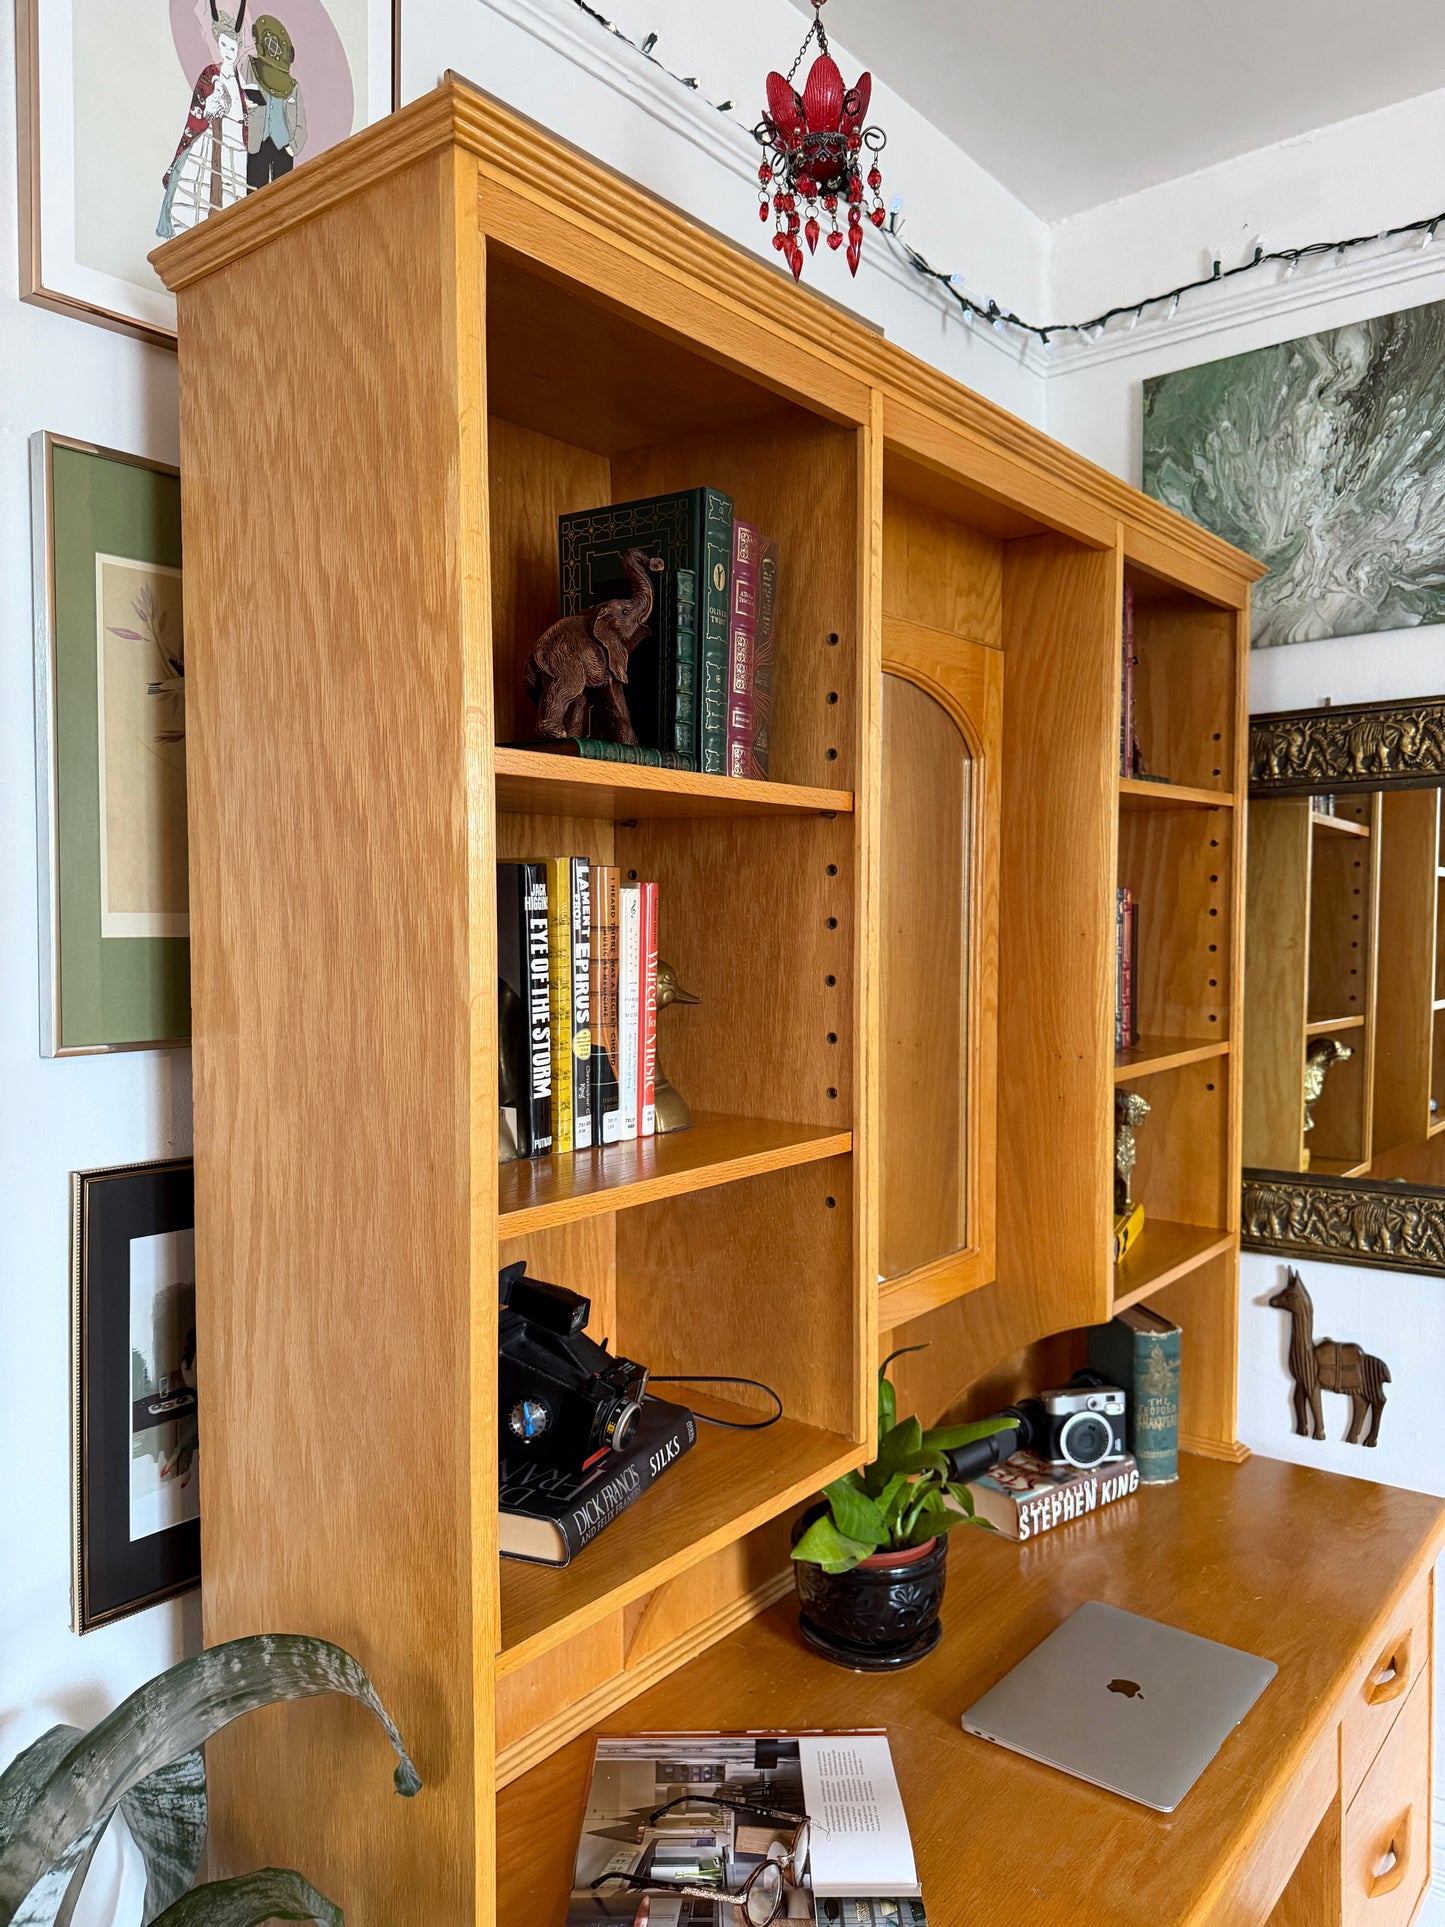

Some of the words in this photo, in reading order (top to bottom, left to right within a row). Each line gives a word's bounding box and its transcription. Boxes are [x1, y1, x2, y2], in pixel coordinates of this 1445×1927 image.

[709, 606, 727, 618] OLIVER
[761, 558, 776, 635] Caravans
[710, 615, 726, 626] TWIST
[530, 883, 547, 897] JACK
[577, 866, 591, 937] LAMENT
[573, 893, 581, 930] FROM
[529, 918, 548, 954] EYE
[530, 958, 550, 982] OF
[575, 942, 591, 1024] EPIRUS
[610, 982, 616, 990] A
[646, 950, 659, 1011] Wired
[531, 984, 550, 1024] THE
[532, 1026, 552, 1100] STORM
[645, 1033, 657, 1093] Music
[578, 1082, 586, 1100] King
[1147, 1397, 1172, 1407] THE
[648, 1434, 681, 1477] SILKS
[572, 1493, 606, 1536] DICK
[600, 1463, 640, 1512] FRANCIS
[1019, 1483, 1098, 1541] STEPHEN
[1100, 1469, 1140, 1506] KING
[1021, 1477, 1098, 1517] DESPERATION
[580, 1526, 597, 1548] AND
[597, 1508, 615, 1533] FELIX
